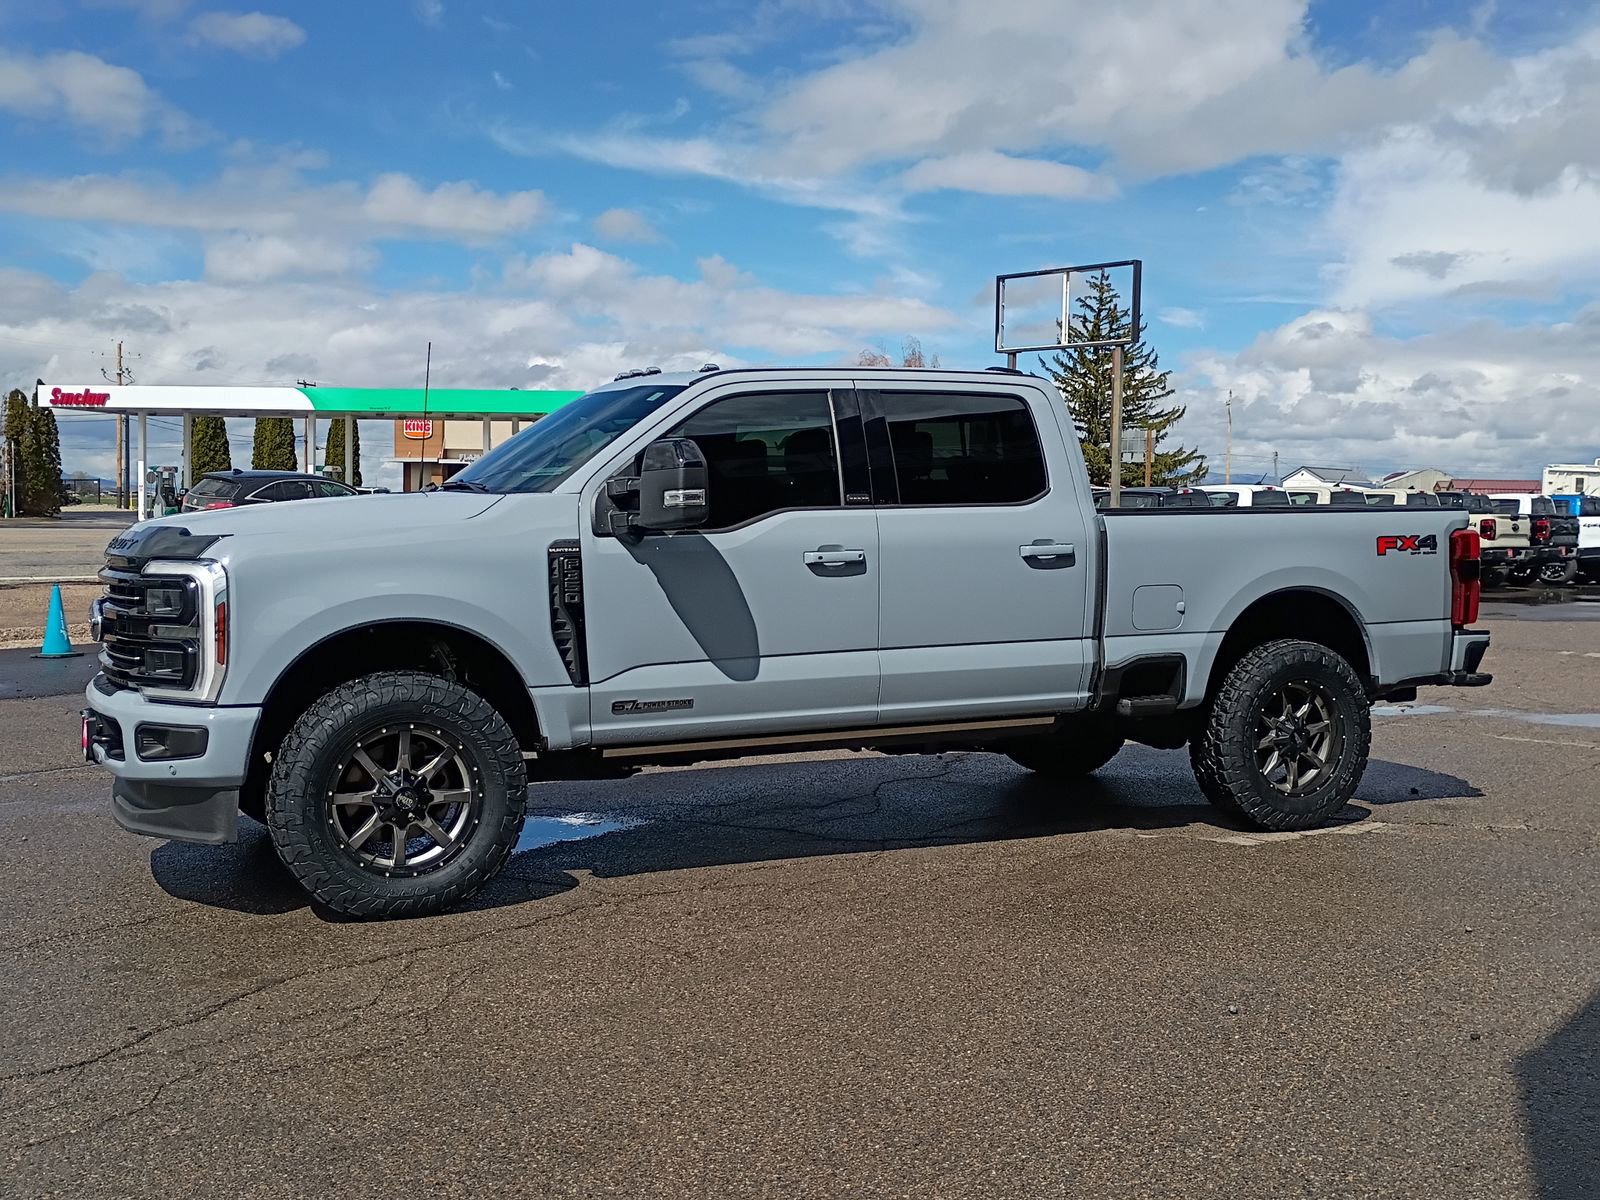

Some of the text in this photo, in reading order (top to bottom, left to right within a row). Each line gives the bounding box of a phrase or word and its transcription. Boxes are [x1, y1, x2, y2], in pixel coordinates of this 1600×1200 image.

[49, 387, 110, 406] Sinclair
[405, 422, 431, 432] KING
[1376, 535, 1438, 556] FX4
